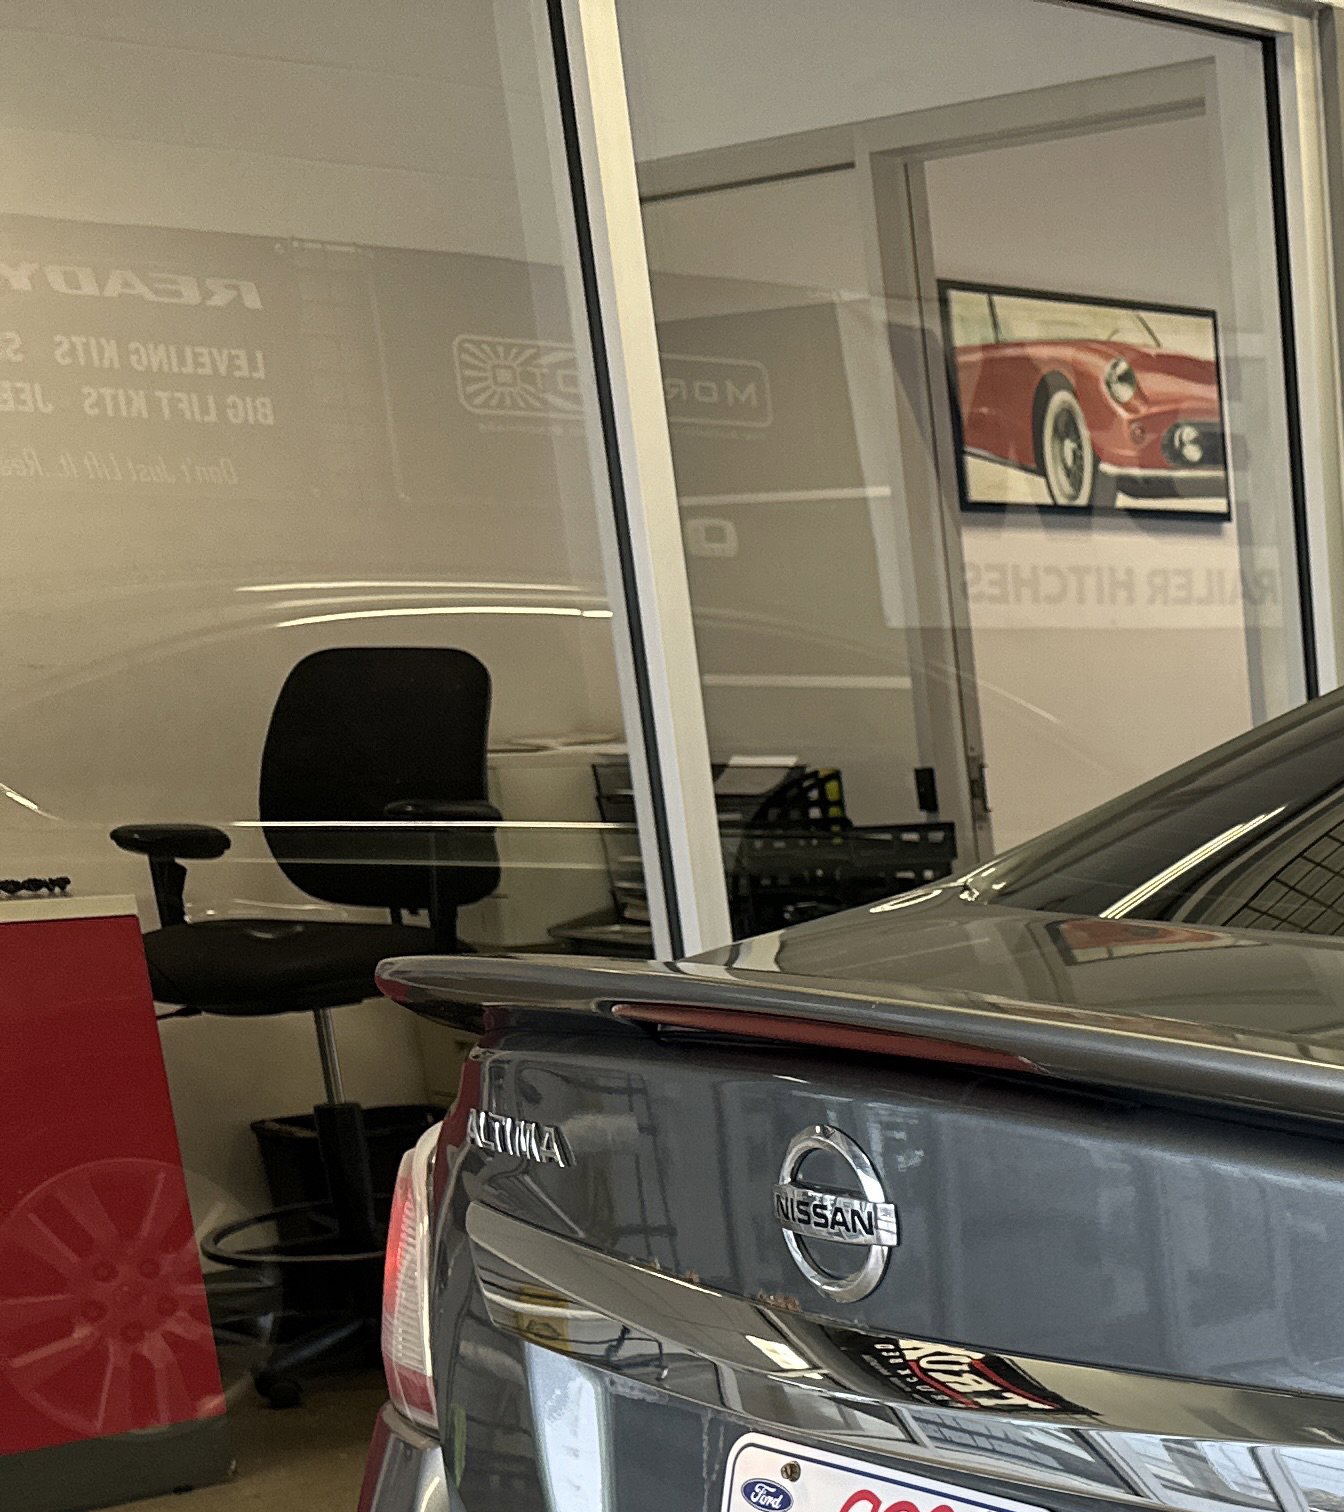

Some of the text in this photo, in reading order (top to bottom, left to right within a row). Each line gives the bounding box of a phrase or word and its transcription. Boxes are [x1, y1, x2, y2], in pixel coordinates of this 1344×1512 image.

[467, 1108, 570, 1168] ALTIMA
[776, 1194, 875, 1235] NISSAN
[750, 1482, 785, 1510] Ford
